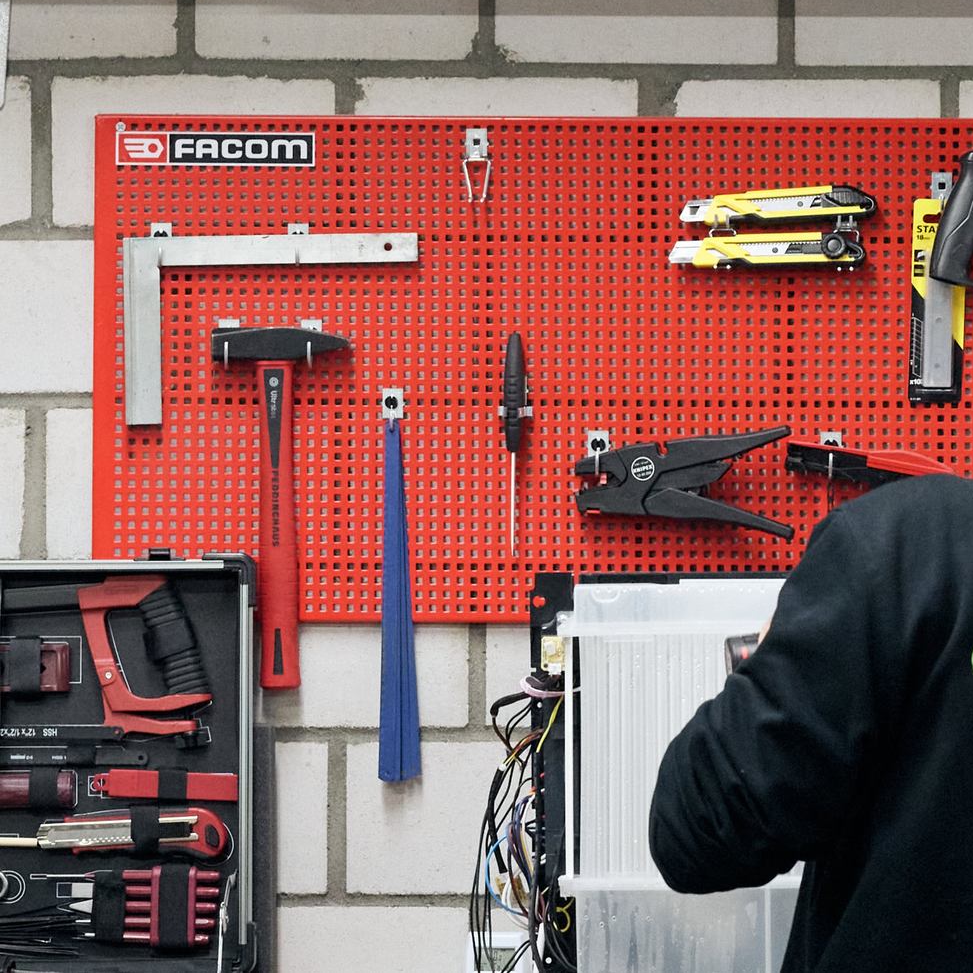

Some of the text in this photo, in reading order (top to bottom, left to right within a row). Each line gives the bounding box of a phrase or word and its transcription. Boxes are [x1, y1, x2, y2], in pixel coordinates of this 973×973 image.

[174, 138, 308, 160] FACOM
[271, 470, 280, 547] PEDDINGHAUS
[42, 728, 58, 737] HSS
